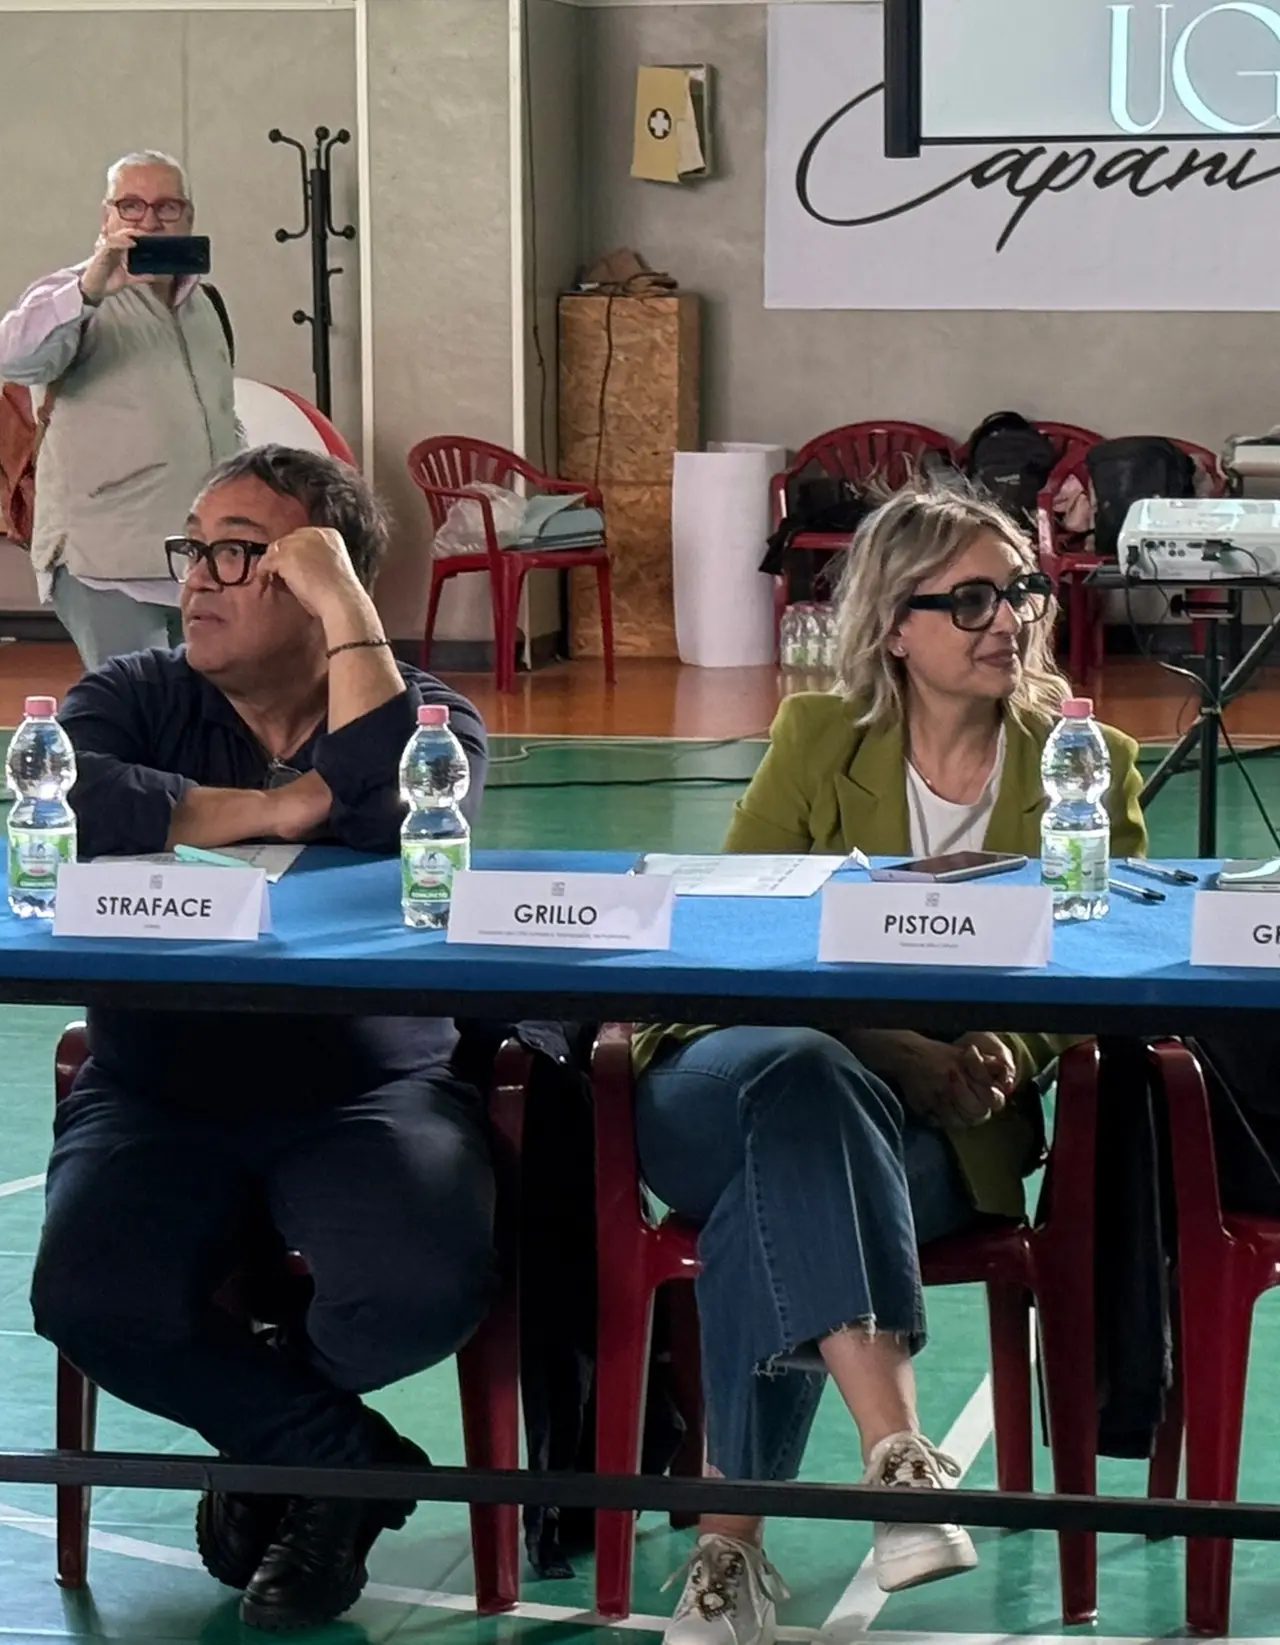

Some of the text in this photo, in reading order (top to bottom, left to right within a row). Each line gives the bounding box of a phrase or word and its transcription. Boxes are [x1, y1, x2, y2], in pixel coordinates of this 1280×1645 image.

[96, 896, 212, 917] STRAFACE
[514, 904, 597, 925] GRILLO
[884, 914, 976, 936] PISTOIA
